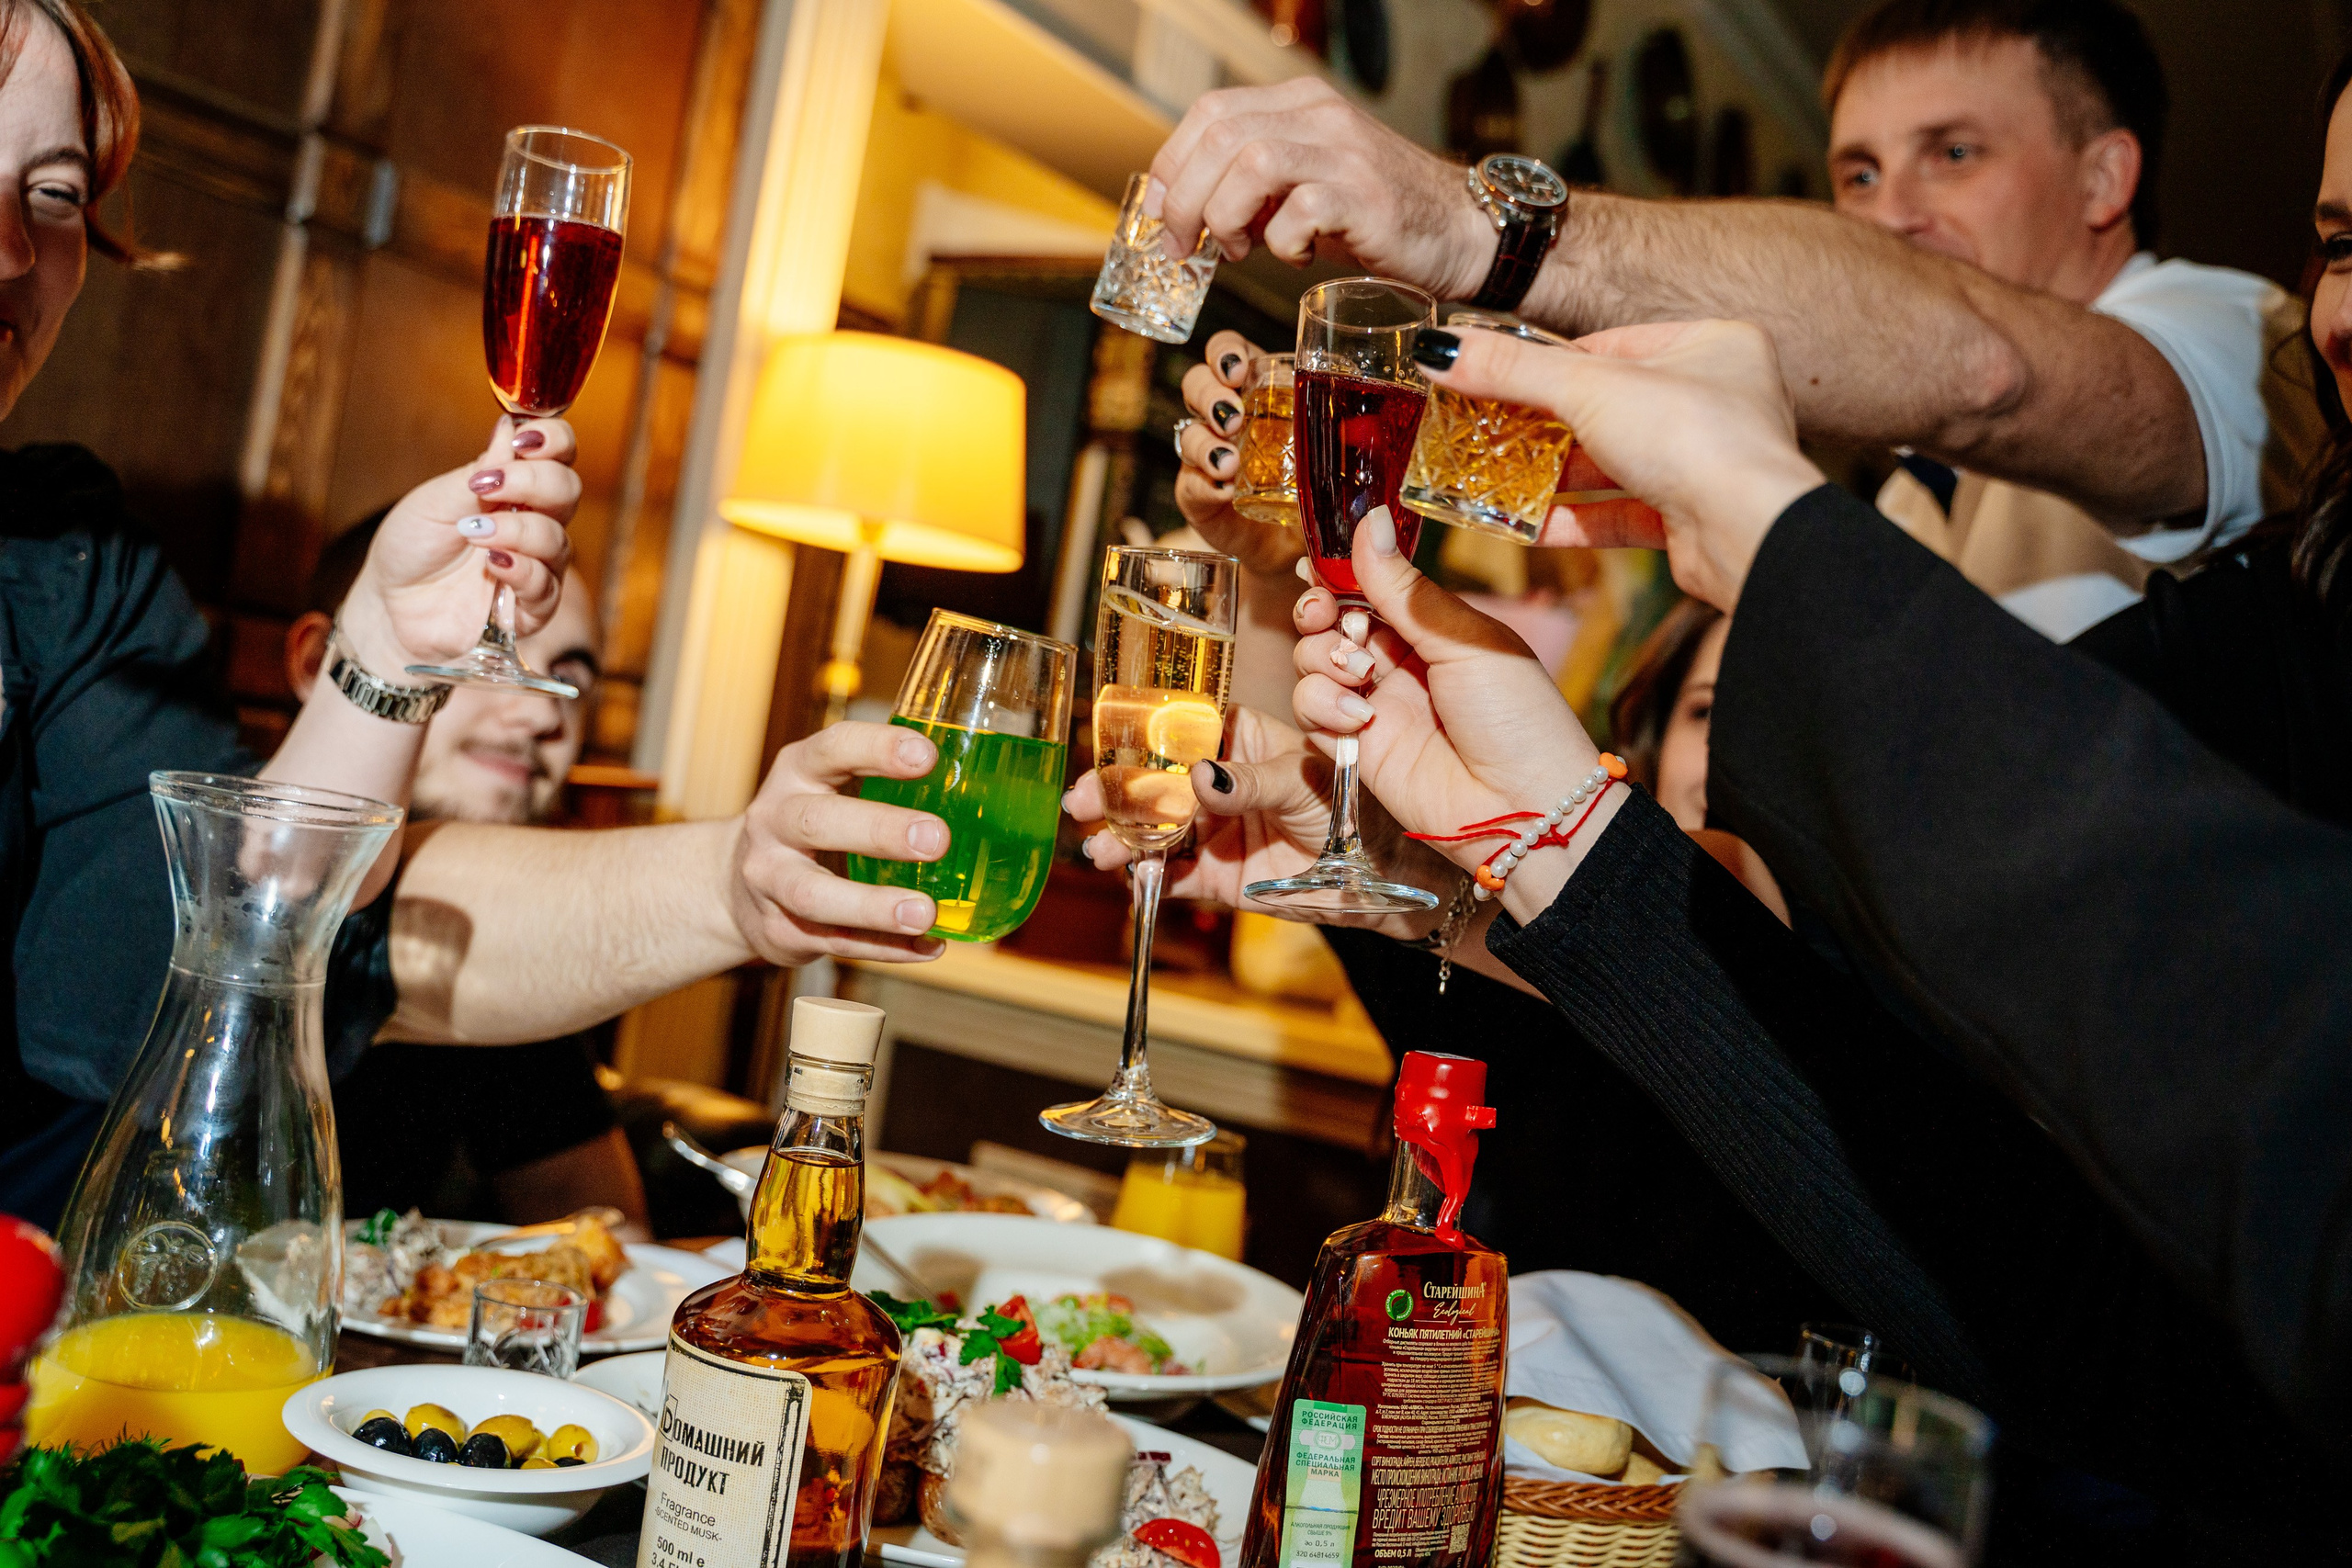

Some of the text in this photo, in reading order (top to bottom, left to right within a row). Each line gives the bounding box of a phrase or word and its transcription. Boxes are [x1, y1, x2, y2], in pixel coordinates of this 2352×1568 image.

[1432, 1299, 1476, 1325] Ecological
[1388, 1326, 1419, 1339] КОНЬЯК
[1419, 1327, 1463, 1340] ПЯТИЛЕТНИЙ
[1302, 1410, 1358, 1423] РОССИЙСКАЯ
[1301, 1417, 1357, 1430] ФЕДЕРАЦИЯ
[1296, 1451, 1356, 1464] ФЕДЕРАЛЬНАЯ
[661, 1445, 730, 1495] ПРОДУКТ
[1295, 1459, 1355, 1472] СПЕЦИАЛЬНАЯ
[1310, 1468, 1340, 1478] МАРКА
[1377, 1488, 1416, 1508] ЧРЕЗМЕРНОЕ
[1416, 1485, 1456, 1507] УПОТРЕБЛЕНИЕ
[662, 1491, 716, 1527] Fragrance
[1372, 1502, 1476, 1533] ВРЕДИТ ВАШЕМУ ЗДОРОВЬЮ
[657, 1535, 674, 1556] 500
[678, 1550, 694, 1564] ml
[1315, 1540, 1329, 1548] 0,5
[1295, 1550, 1340, 1559] 320 64814659
[1374, 1549, 1396, 1558] ОБЪЕМ
[1396, 1549, 1407, 1559] 0,5
[1407, 1548, 1412, 1558] Л
